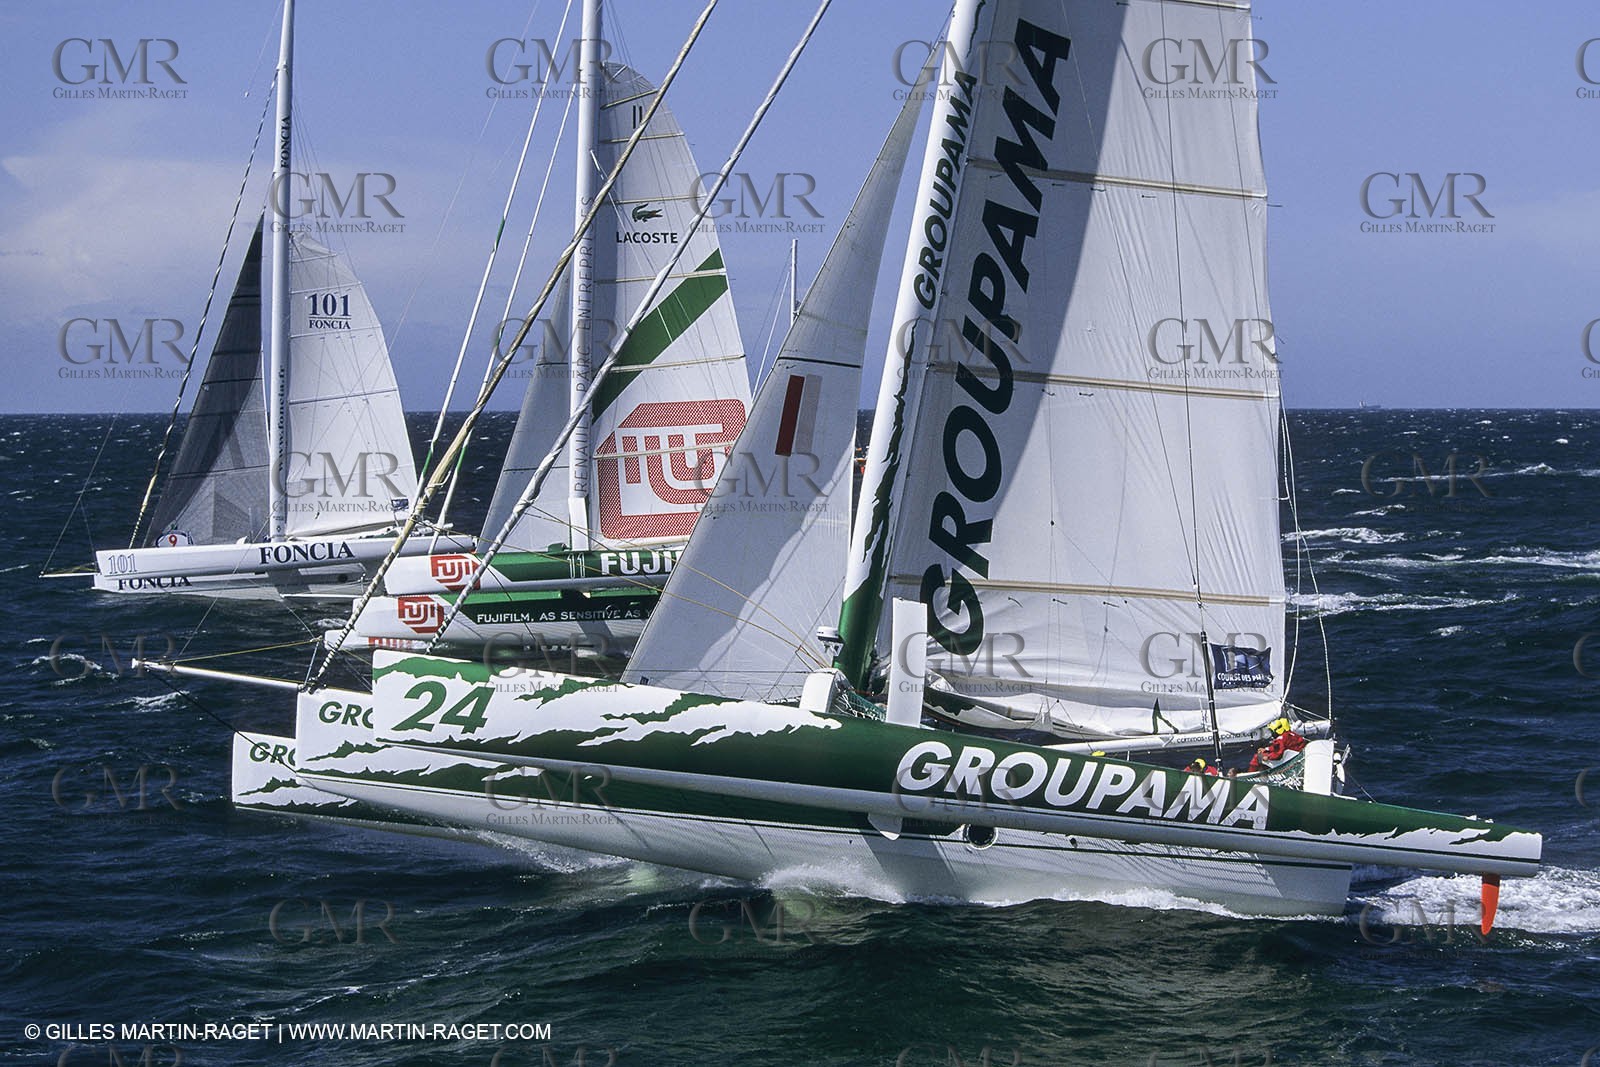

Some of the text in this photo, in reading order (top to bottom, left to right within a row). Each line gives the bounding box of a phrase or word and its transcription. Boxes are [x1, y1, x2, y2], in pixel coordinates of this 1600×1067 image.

[280, 115, 291, 168] FONCIA
[914, 70, 978, 310] GROUPAMA
[616, 232, 679, 244] LACOSTE
[308, 293, 352, 317] 101
[308, 319, 352, 330] FONCIA
[919, 18, 1072, 656] GROUPAMA
[574, 408, 589, 493] RENAUL
[168, 534, 178, 547] 9
[259, 541, 355, 565] FONCIA
[108, 553, 138, 575] 101
[567, 552, 586, 578] 11
[540, 612, 556, 621] AS
[391, 681, 498, 736] 24
[897, 741, 1270, 830] GROUPAMA
